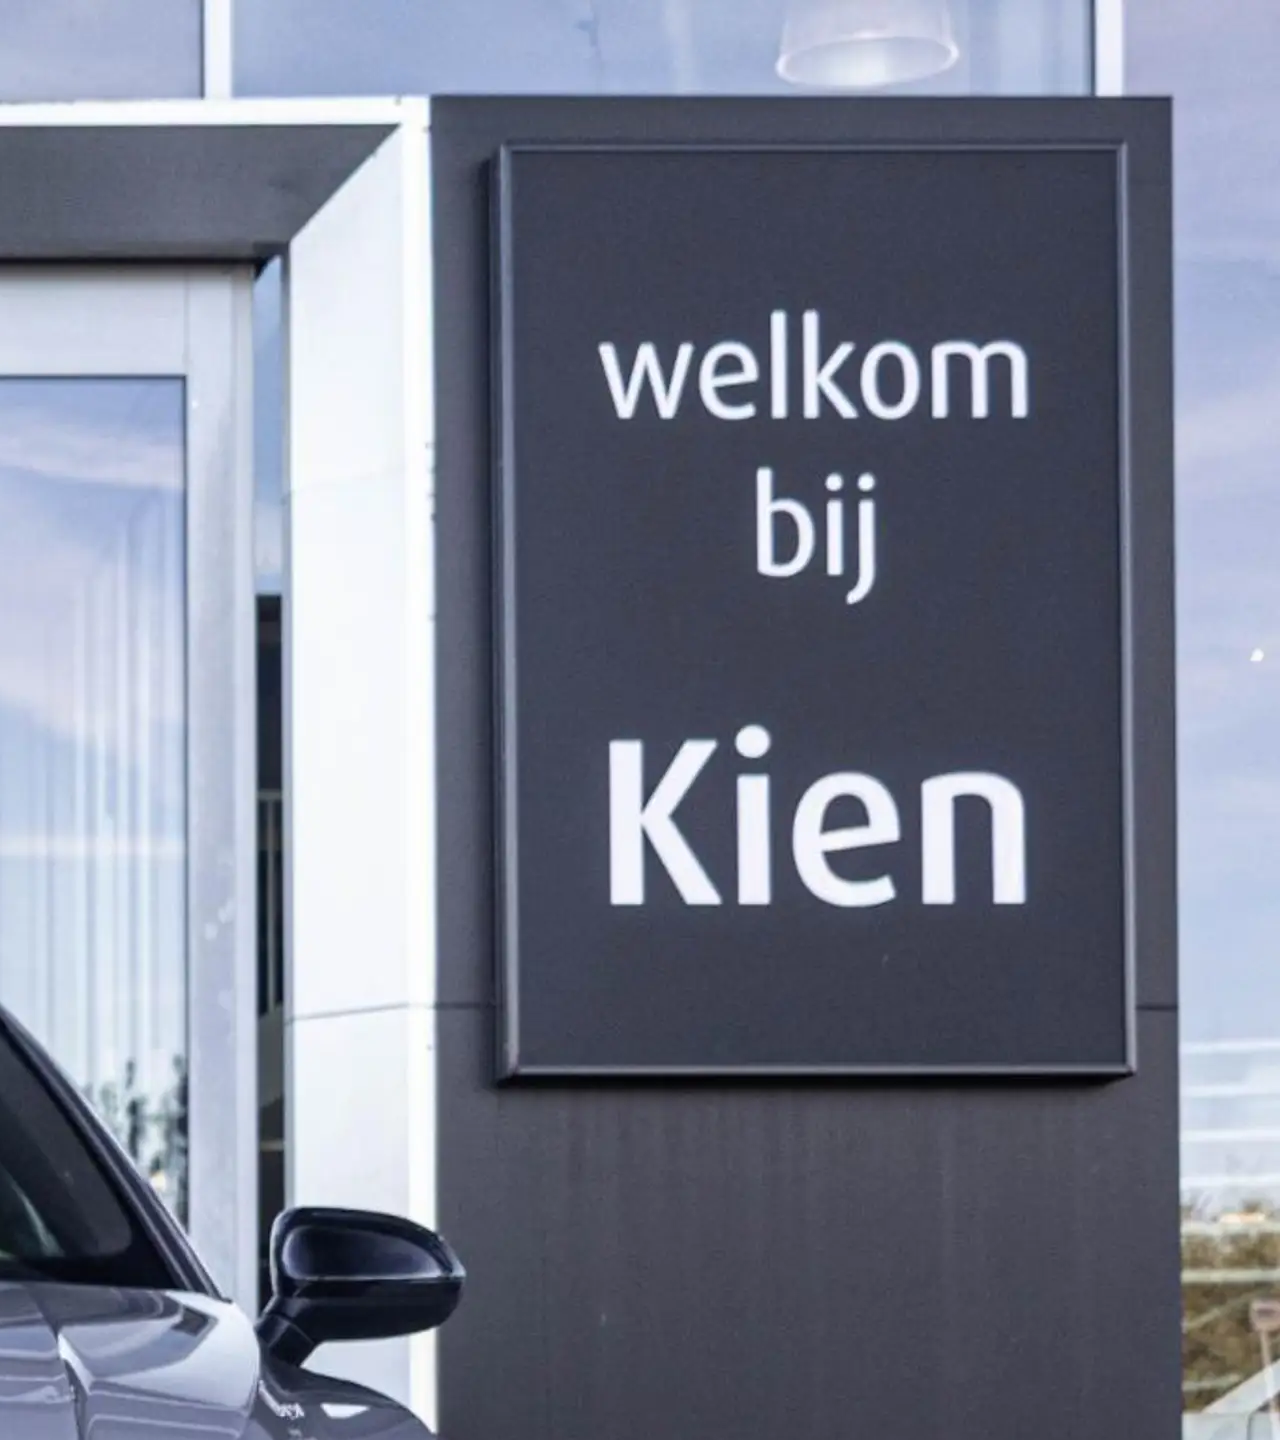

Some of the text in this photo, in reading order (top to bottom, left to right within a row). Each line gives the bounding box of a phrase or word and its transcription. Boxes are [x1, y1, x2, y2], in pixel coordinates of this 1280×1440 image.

[598, 310, 1028, 420] welkom
[756, 467, 876, 605] bij
[608, 724, 1026, 908] Kien
